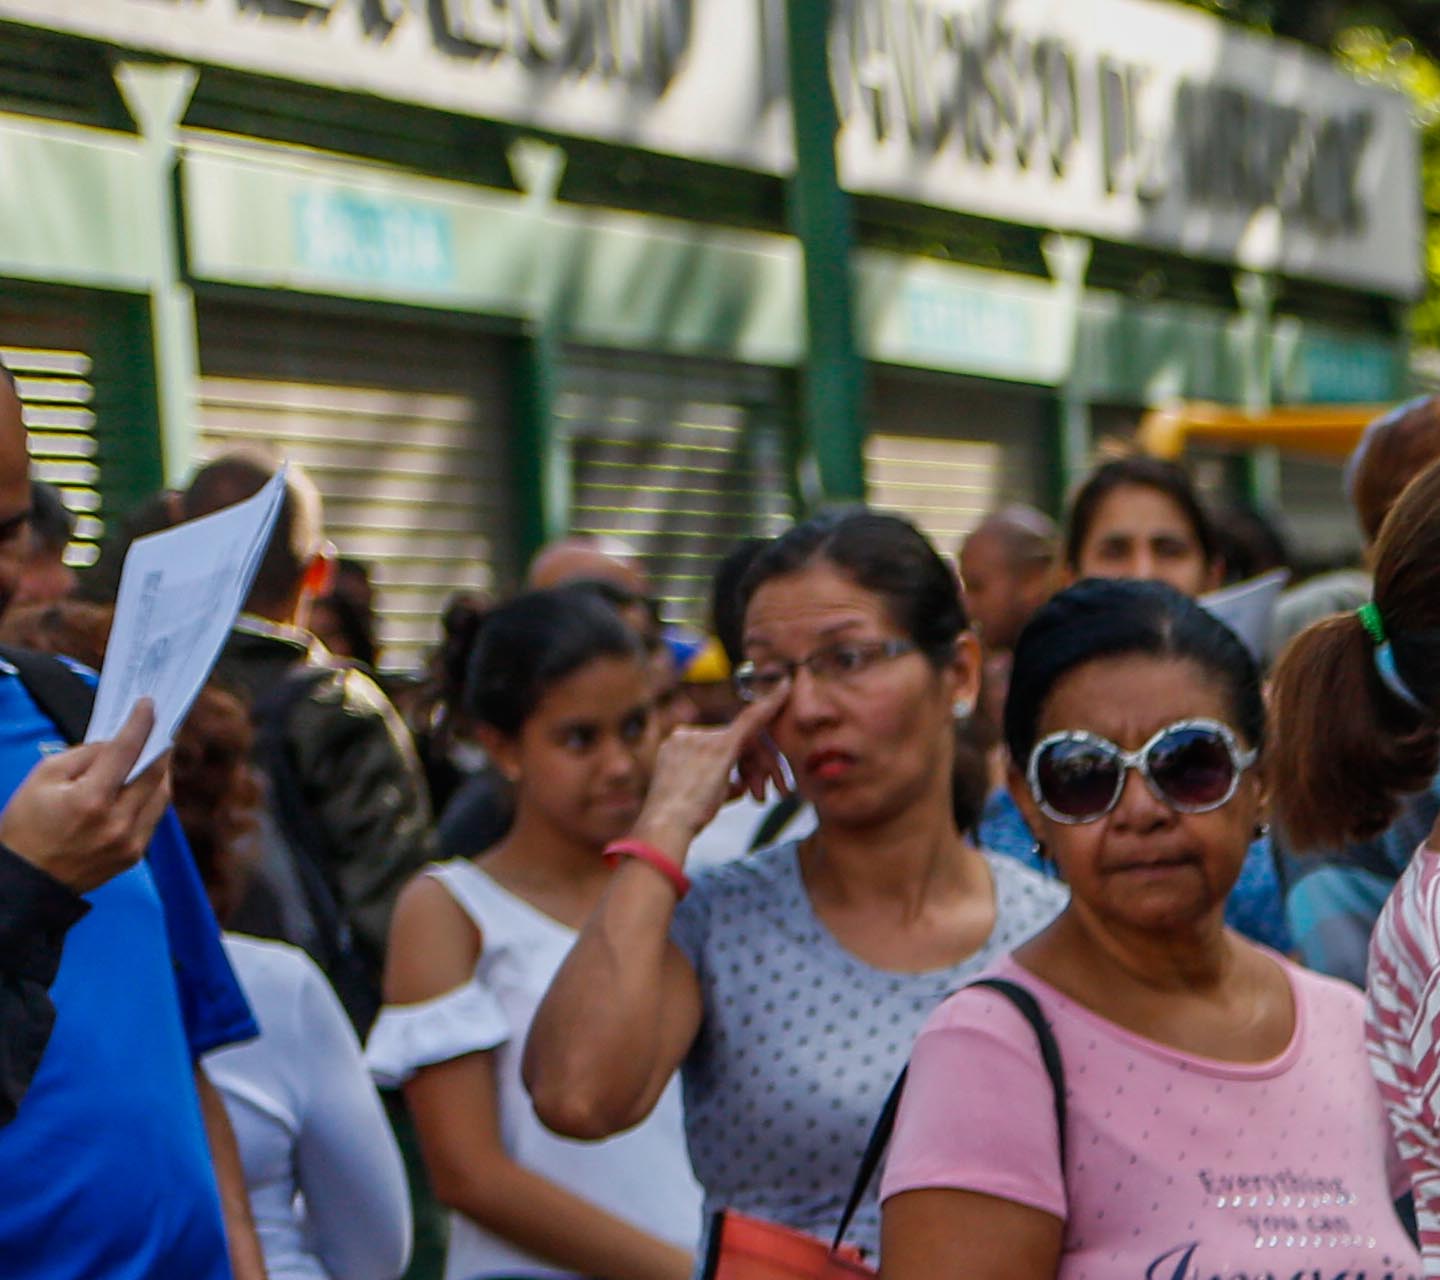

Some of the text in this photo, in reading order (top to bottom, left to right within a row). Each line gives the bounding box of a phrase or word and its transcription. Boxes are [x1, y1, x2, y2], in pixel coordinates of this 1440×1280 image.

[1198, 1168, 1350, 1203] Everything
[1241, 1214, 1350, 1236] you can
